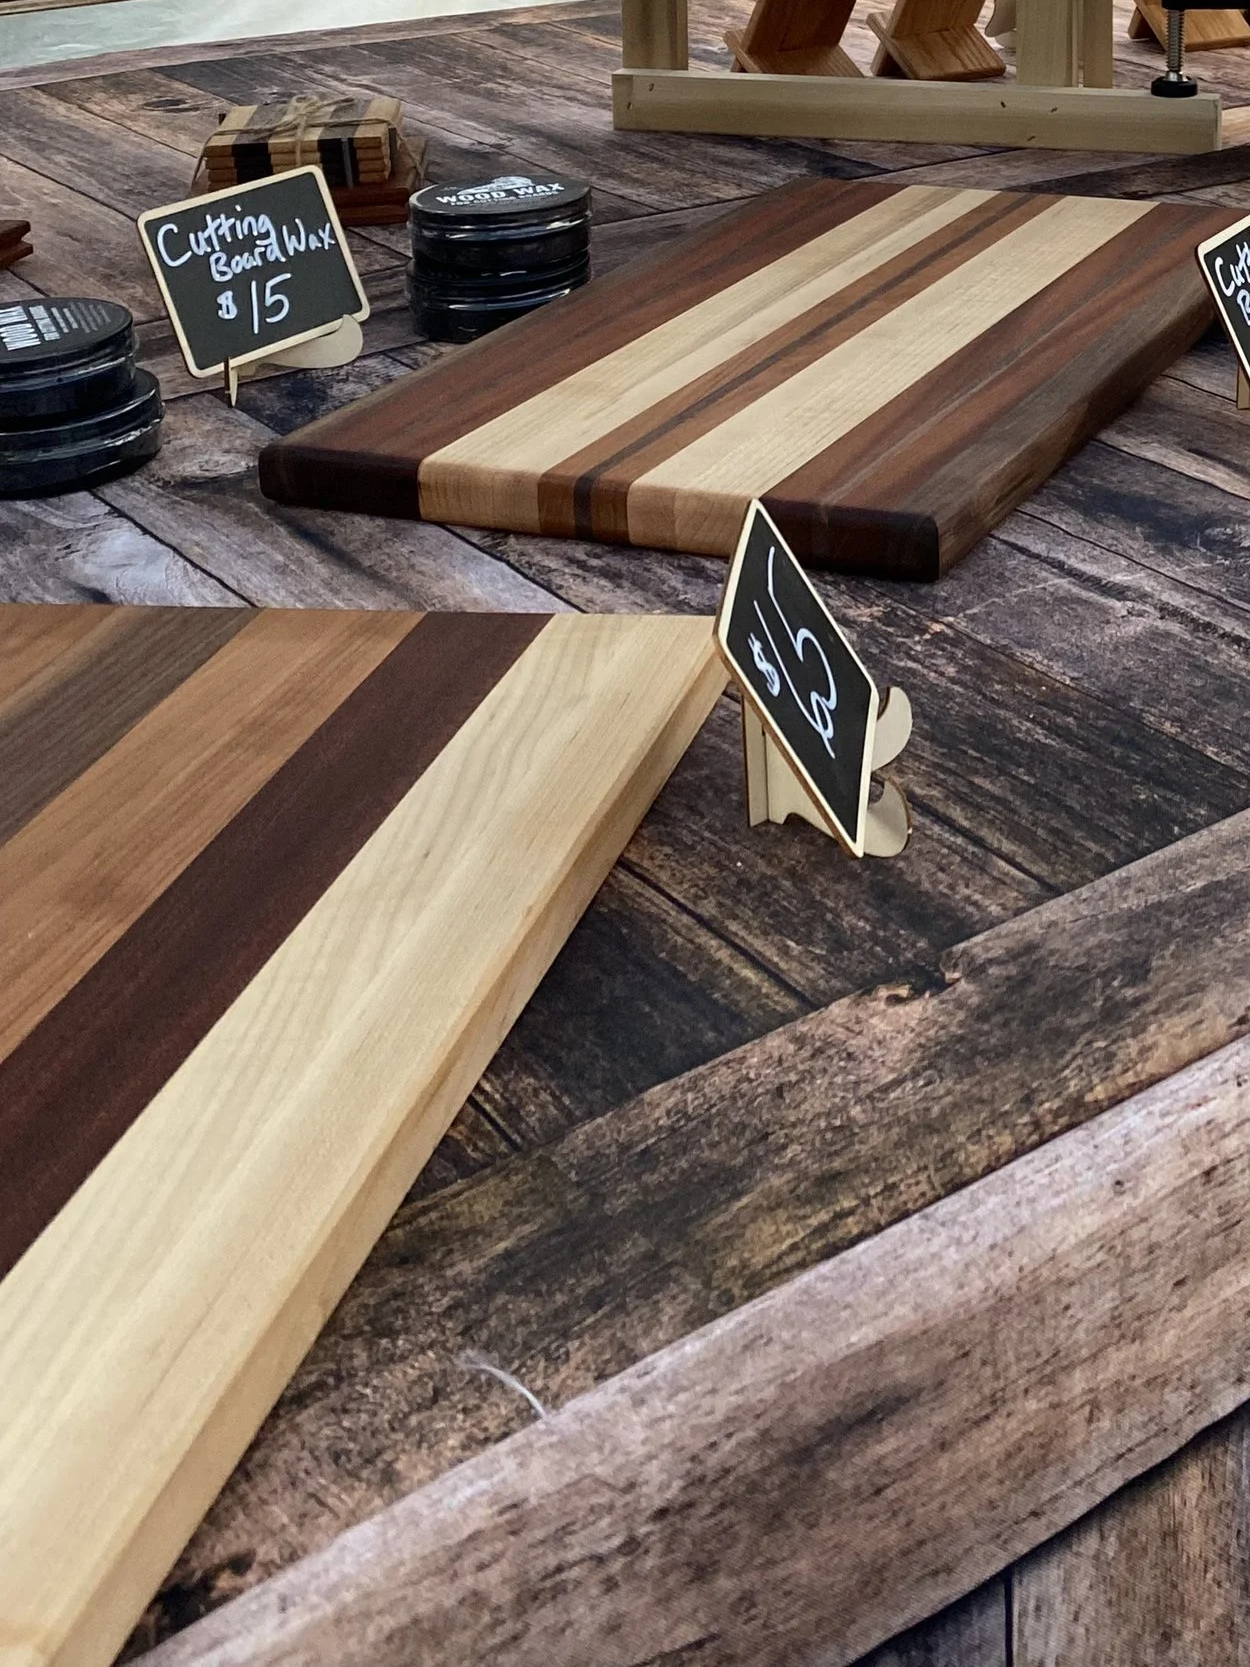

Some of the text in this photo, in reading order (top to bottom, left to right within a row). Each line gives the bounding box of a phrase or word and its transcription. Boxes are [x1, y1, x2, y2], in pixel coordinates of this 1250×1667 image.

[436, 183, 565, 203] WOOD WAX
[157, 205, 276, 267] Cutting
[210, 218, 337, 282] Board Wax
